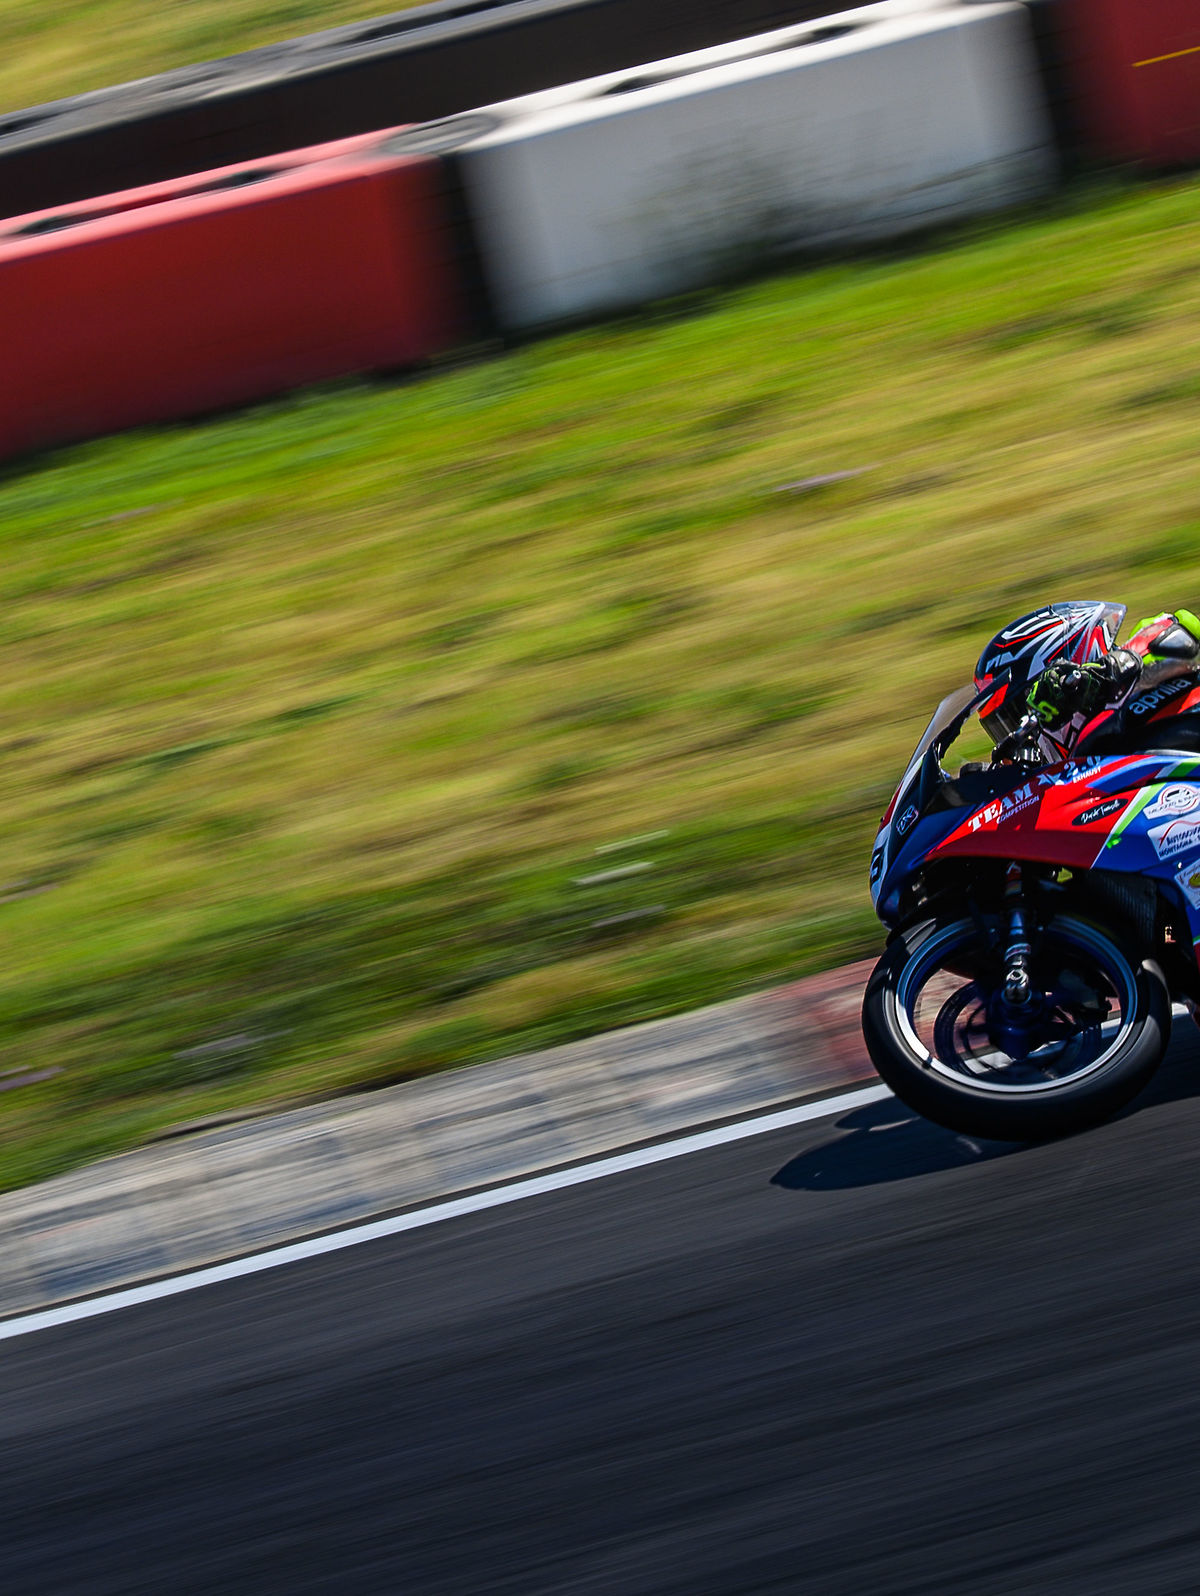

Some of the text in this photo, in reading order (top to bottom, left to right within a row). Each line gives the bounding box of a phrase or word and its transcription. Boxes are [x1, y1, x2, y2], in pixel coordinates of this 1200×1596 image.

[1128, 679, 1192, 715] aprilia
[968, 783, 1033, 832] TEAM
[996, 795, 1040, 824] COMPETITION
